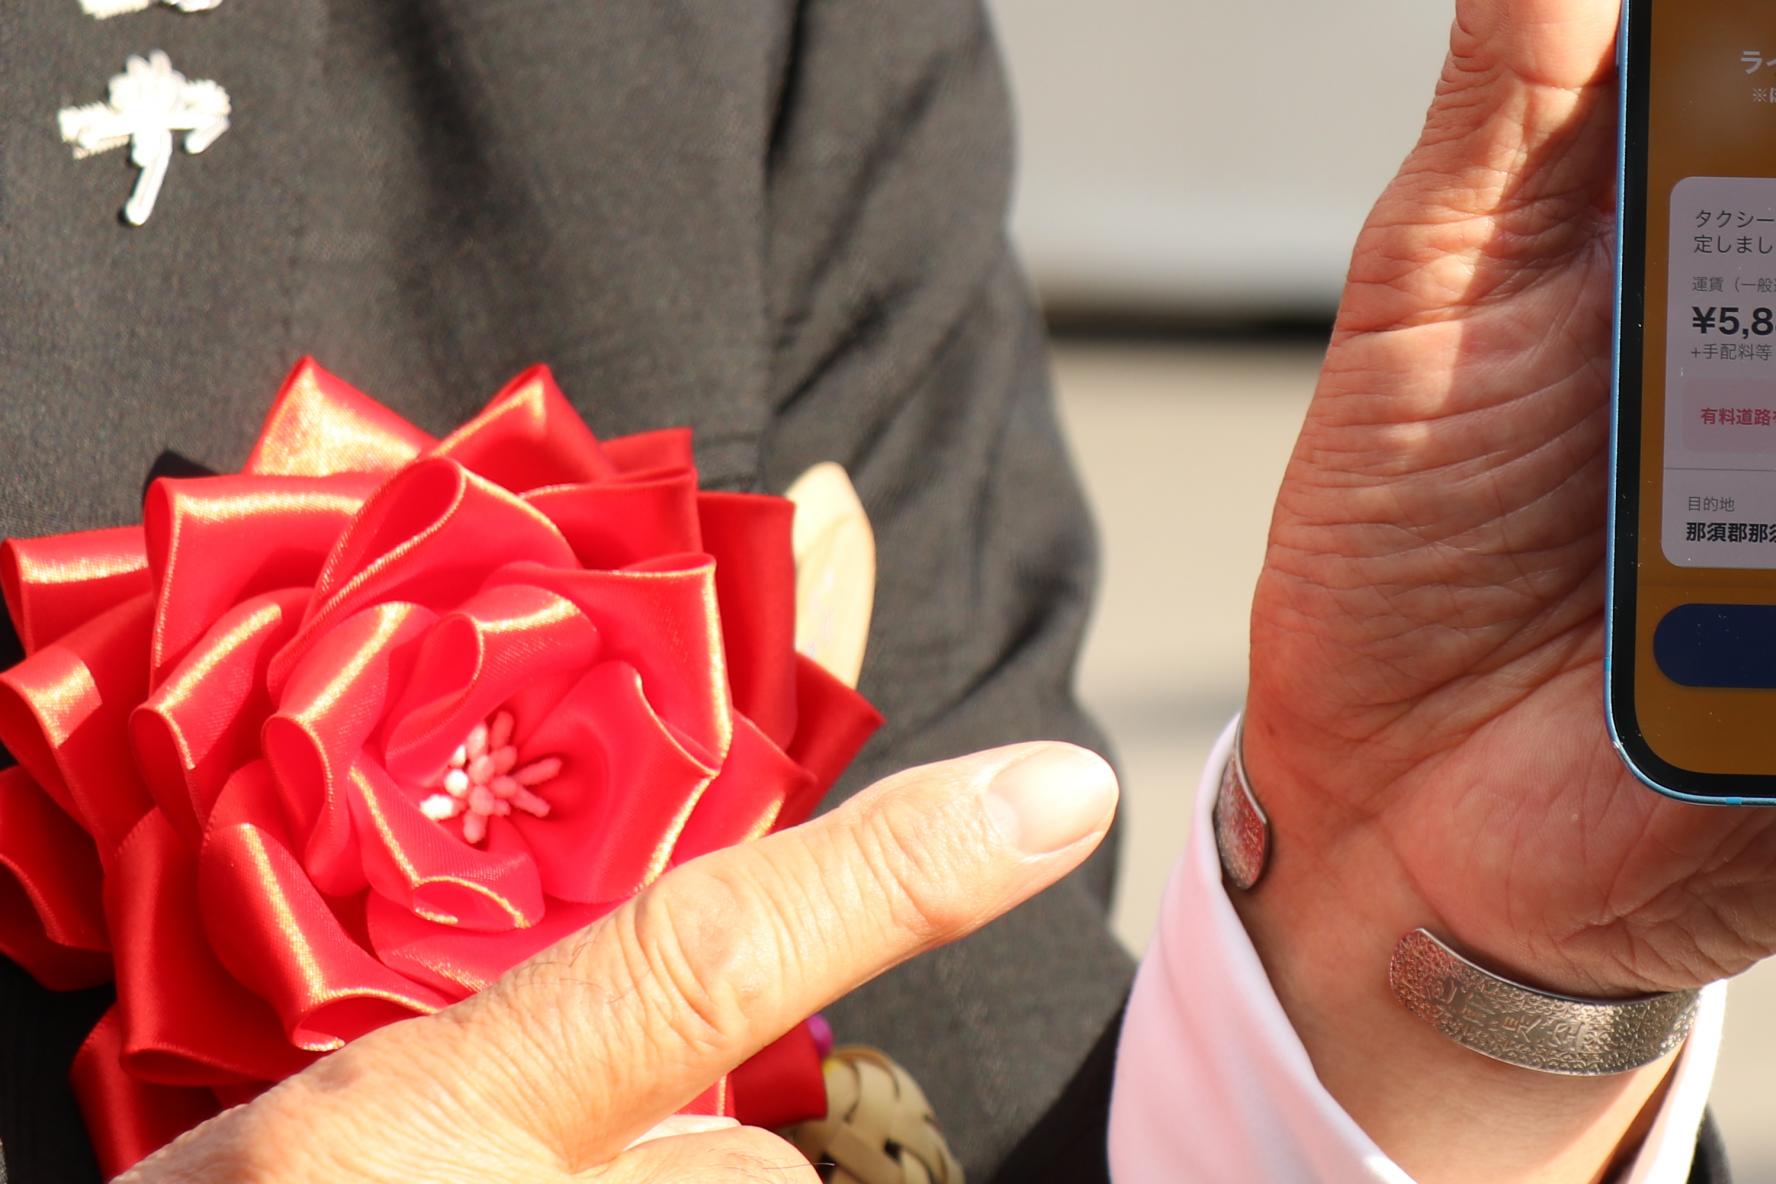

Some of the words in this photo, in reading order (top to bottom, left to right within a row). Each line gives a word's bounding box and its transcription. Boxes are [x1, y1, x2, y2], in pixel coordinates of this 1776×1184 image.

[1690, 343, 1773, 362] +手配料等
[1687, 495, 1735, 513] 目的地
